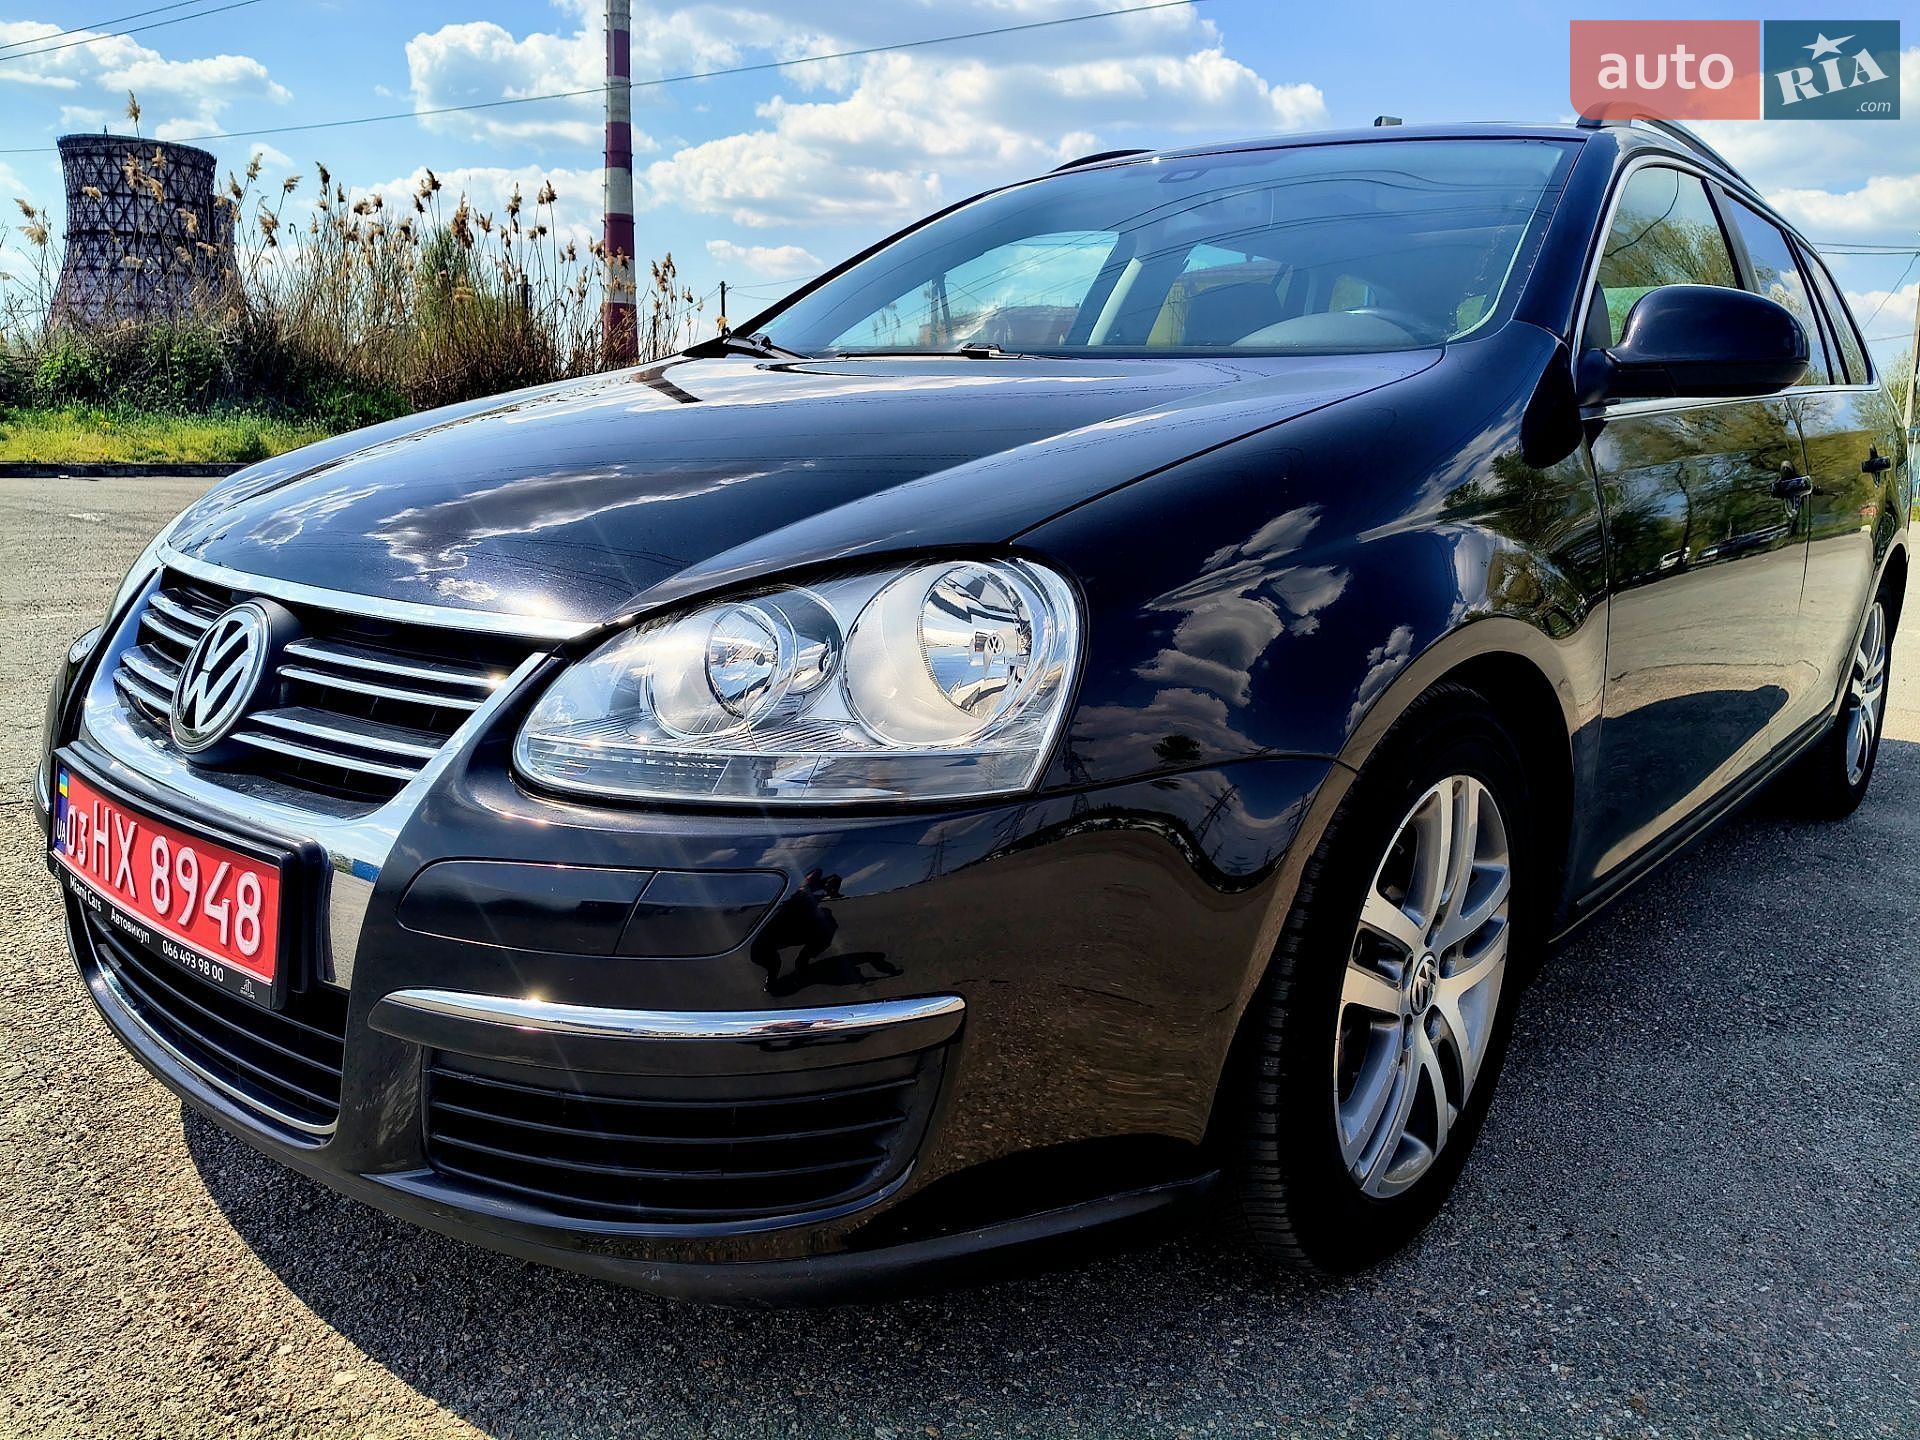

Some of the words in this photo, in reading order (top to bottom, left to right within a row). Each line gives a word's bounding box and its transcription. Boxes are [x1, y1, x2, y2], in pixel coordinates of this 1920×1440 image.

[57, 817, 66, 844] UA
[69, 874, 87, 902] Miami
[87, 889, 102, 912] Cars
[150, 835, 263, 956] 8948
[111, 907, 150, 944] Автовикуп
[162, 940, 178, 960] 066
[179, 949, 196, 969] 493
[198, 958, 210, 976] 98
[211, 965, 224, 982] 00
